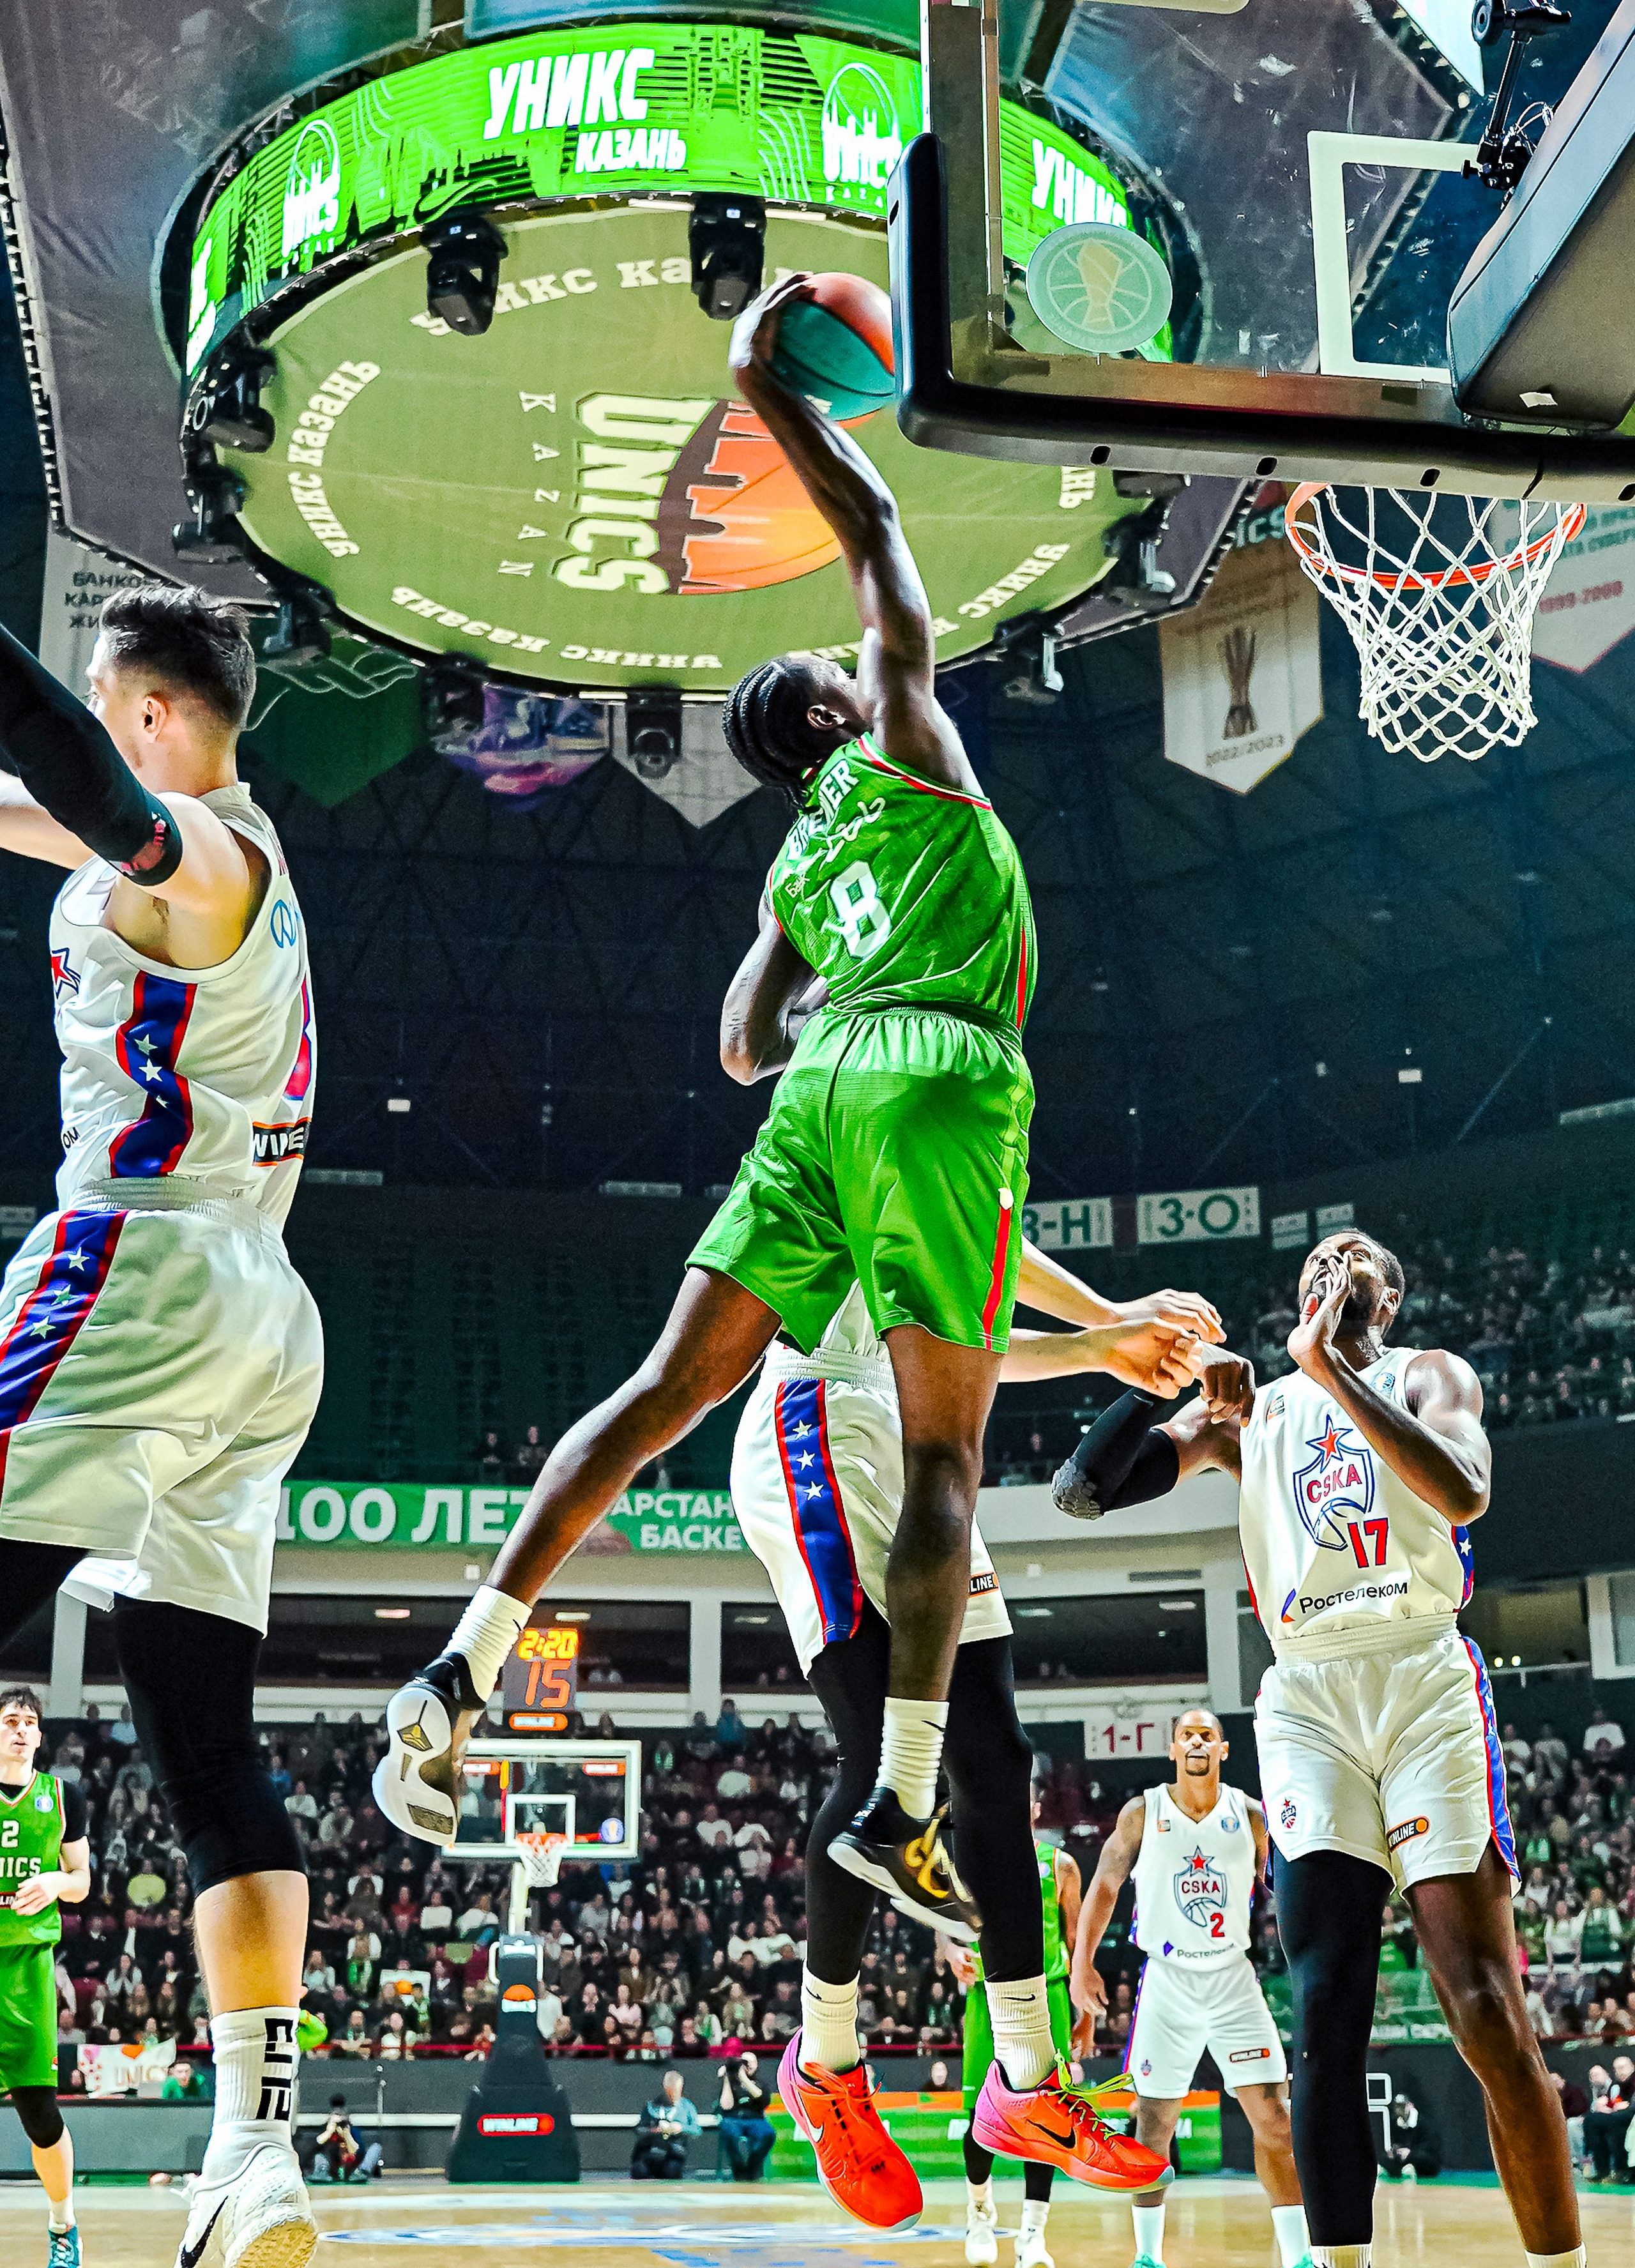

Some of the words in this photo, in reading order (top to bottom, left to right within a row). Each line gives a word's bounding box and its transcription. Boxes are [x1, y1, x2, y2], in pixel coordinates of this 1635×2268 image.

[483, 48, 655, 141] УНИКС
[575, 128, 688, 174] КАЗАНЬ
[498, 390, 561, 578] KAZAN
[553, 392, 716, 595] UNICS
[830, 859, 894, 960] 8
[1307, 1463, 1363, 1503] CSKA
[1348, 1518, 1389, 1569] 17
[1299, 1581, 1408, 1614] Ростелеком
[517, 1628, 578, 1660] 2:20
[525, 1660, 571, 1709] 15
[1182, 1880, 1221, 1894] CSKA
[1210, 1912, 1225, 1938] 2
